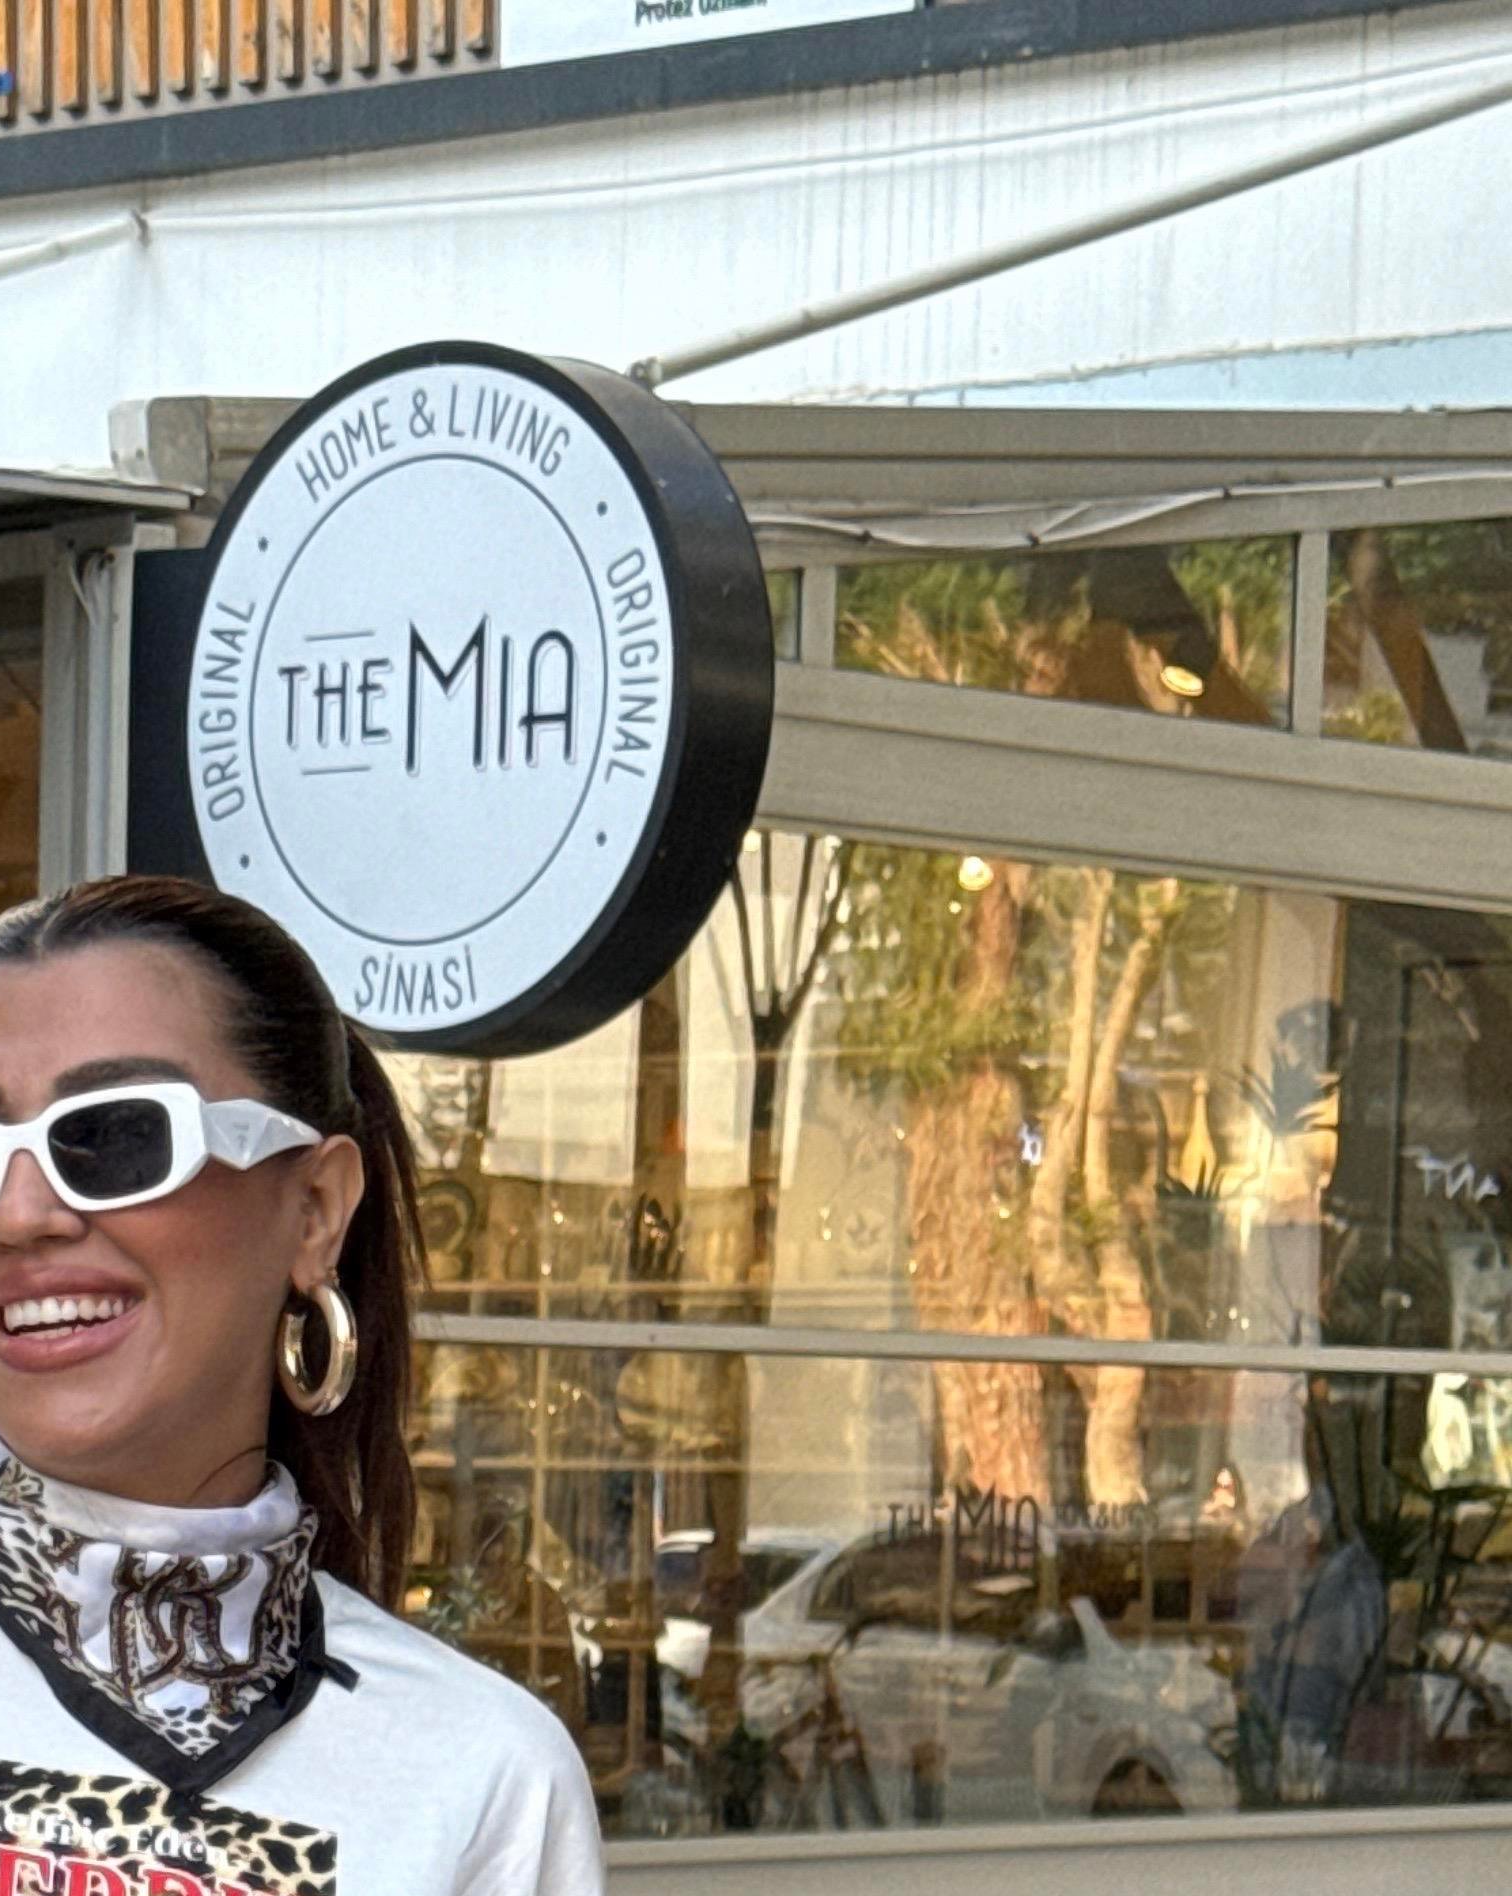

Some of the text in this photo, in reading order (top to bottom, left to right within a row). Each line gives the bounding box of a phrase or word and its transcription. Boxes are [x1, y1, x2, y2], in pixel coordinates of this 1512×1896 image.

[295, 382, 574, 503] HOME & LIVING
[199, 597, 257, 823] ORIGINAL
[277, 612, 579, 777] THE MIA
[605, 546, 663, 784] ORIGINAL
